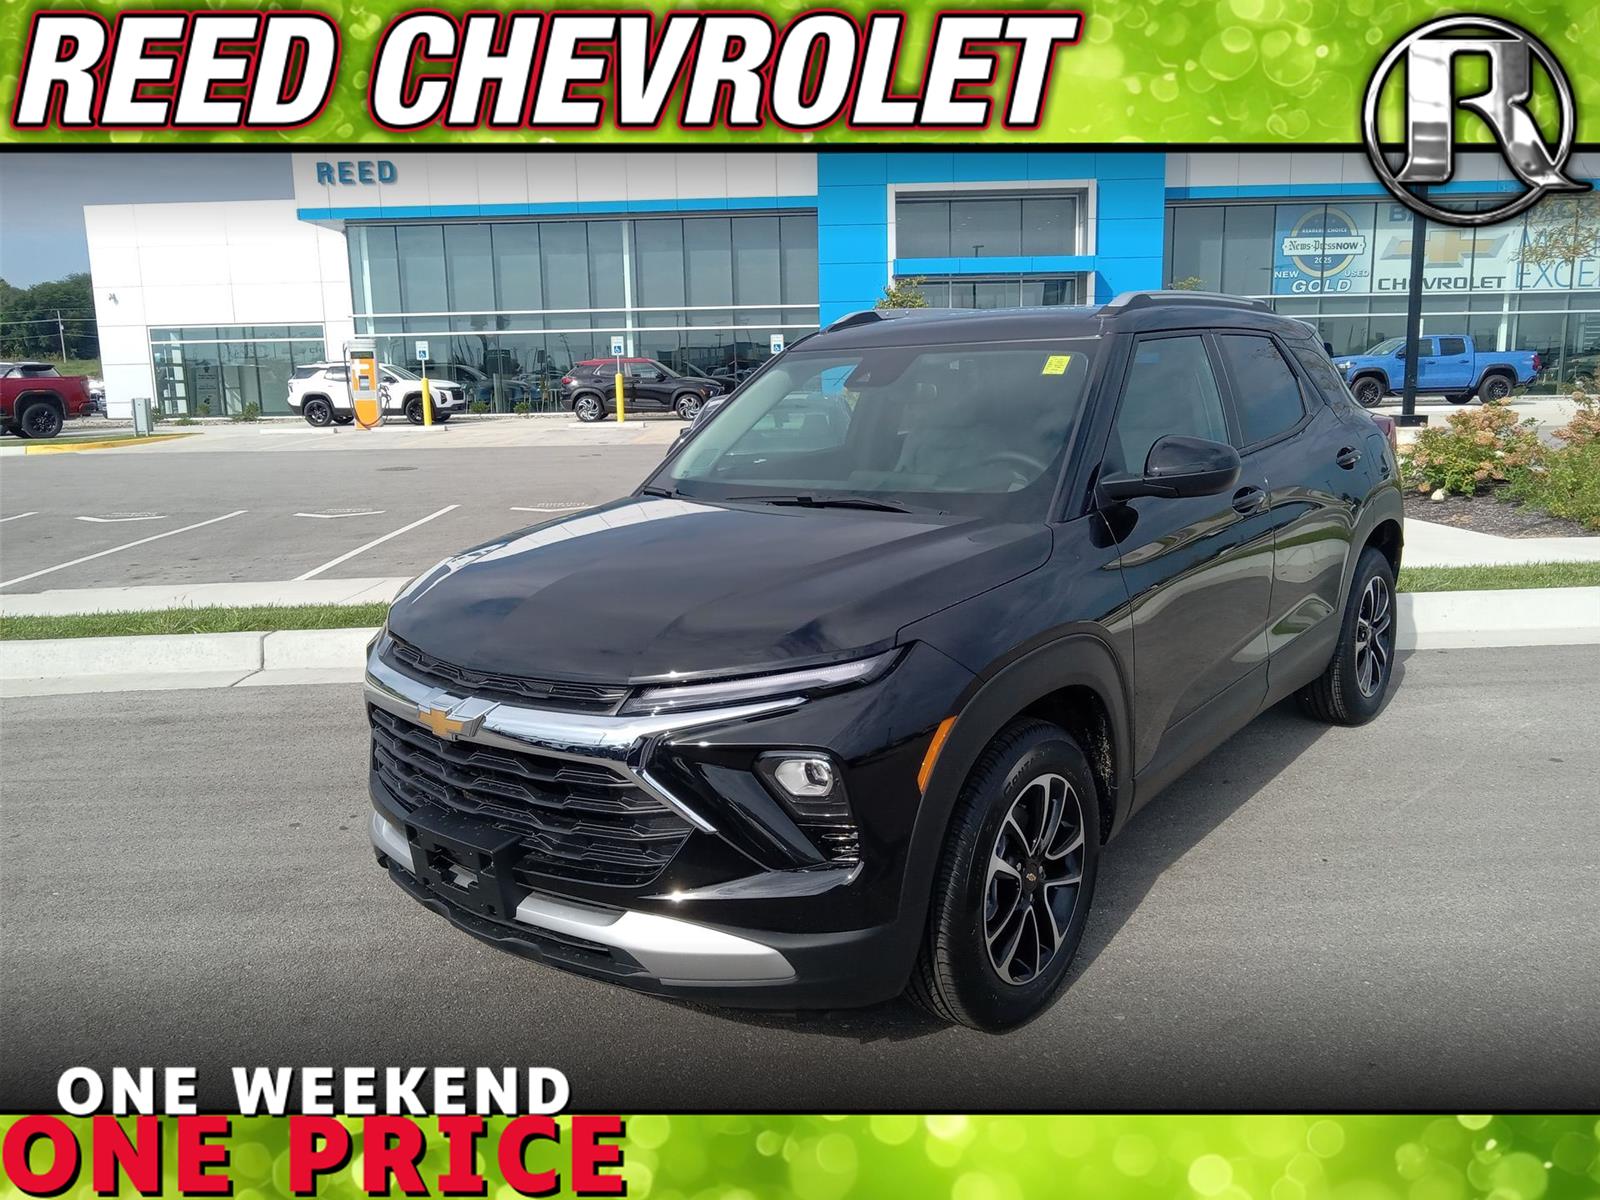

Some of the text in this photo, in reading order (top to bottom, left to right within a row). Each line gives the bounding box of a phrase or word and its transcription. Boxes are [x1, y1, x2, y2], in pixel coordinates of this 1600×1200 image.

[315, 160, 398, 186] REED
[1274, 271, 1299, 279] NEW
[1344, 270, 1370, 278] USED
[1291, 279, 1352, 294] GOLD
[1378, 276, 1507, 291] CHVROLET
